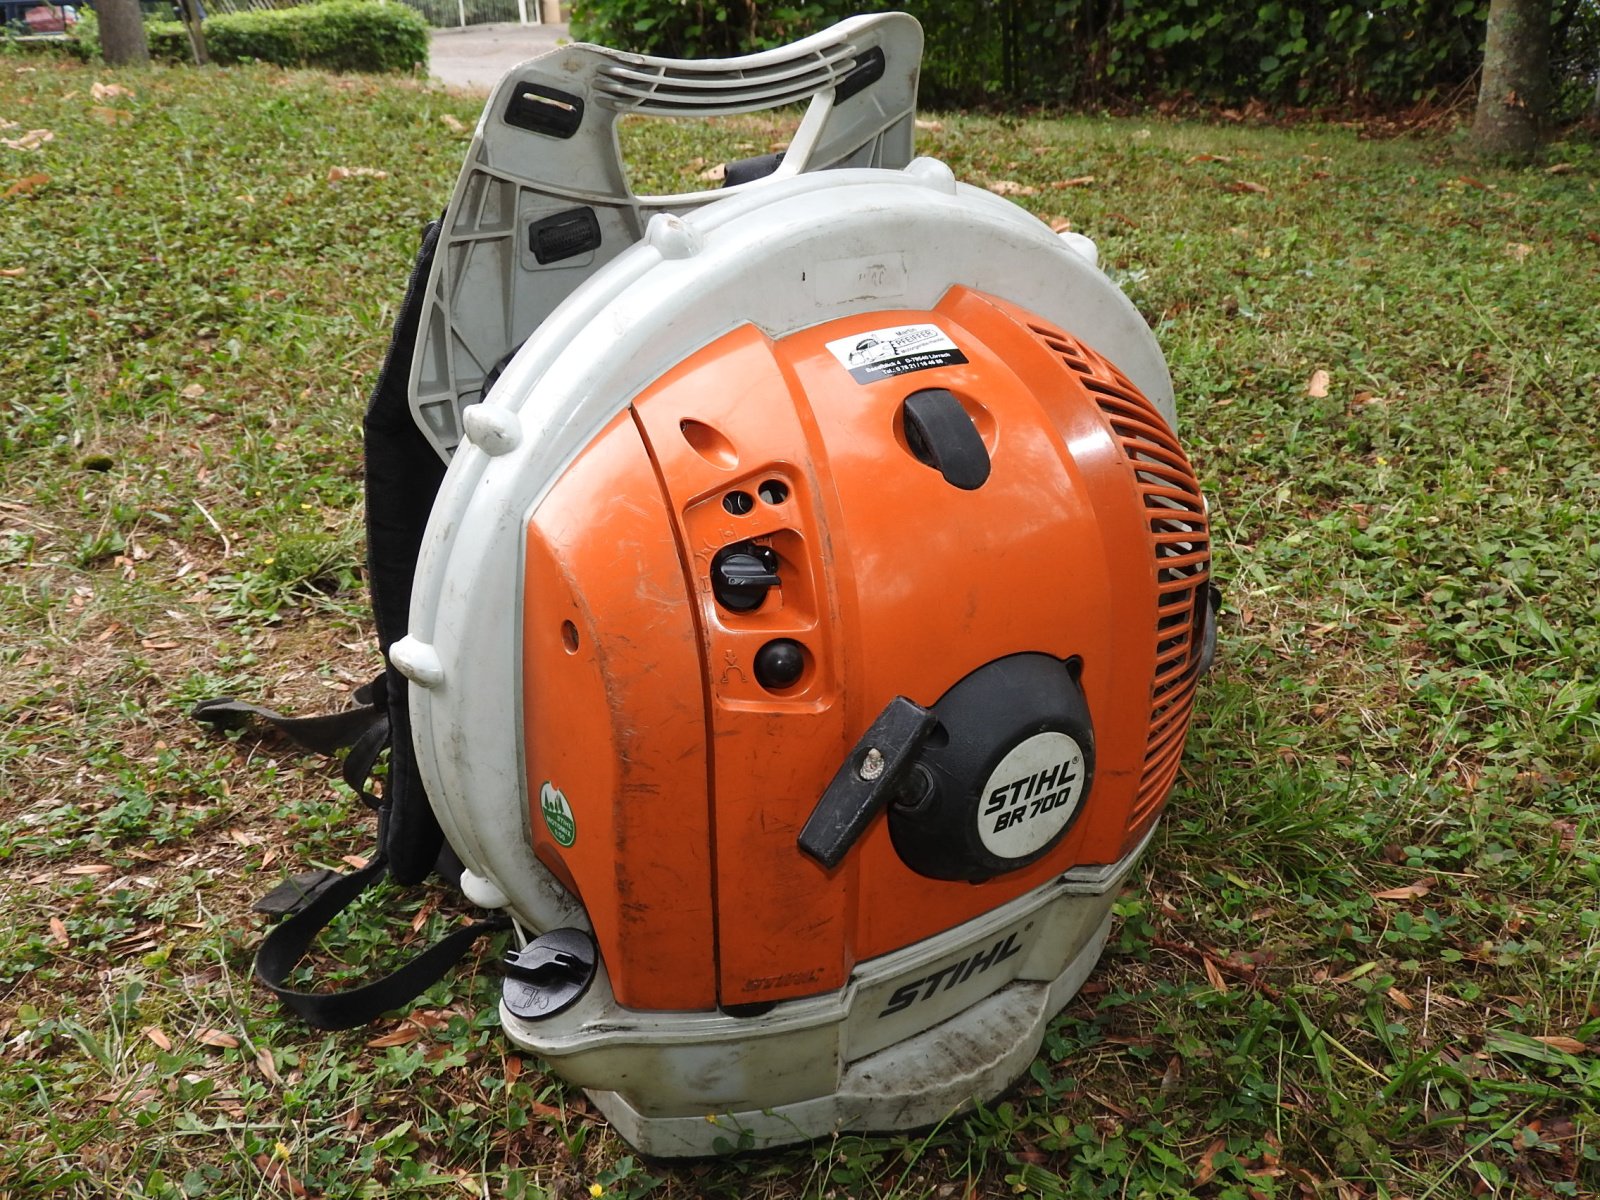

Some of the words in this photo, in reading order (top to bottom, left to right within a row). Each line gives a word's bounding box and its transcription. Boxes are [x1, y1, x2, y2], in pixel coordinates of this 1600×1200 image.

[895, 329, 934, 345] PFEIFFER
[984, 760, 1076, 816] STIHL
[556, 815, 573, 831] STIHL
[993, 805, 1027, 834] BR
[1029, 787, 1071, 819] 700
[742, 970, 820, 992] STIHL
[878, 932, 1022, 1018] STIHL
